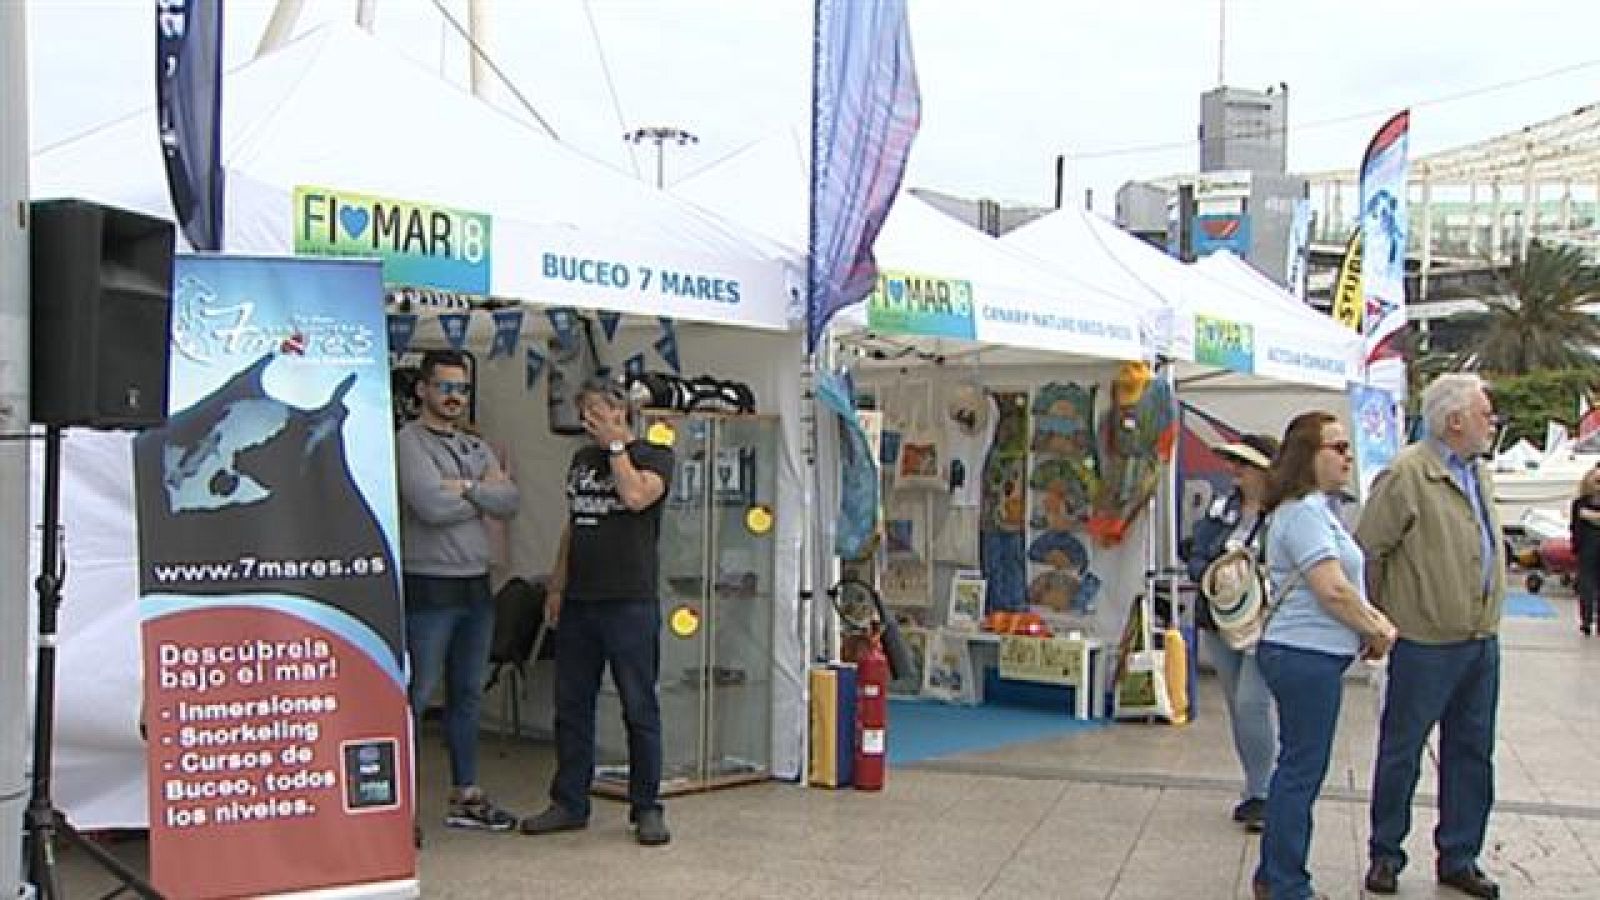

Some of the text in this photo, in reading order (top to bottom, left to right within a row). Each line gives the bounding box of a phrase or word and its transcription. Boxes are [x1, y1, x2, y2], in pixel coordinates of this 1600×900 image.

[542, 252, 741, 304] BUCEO 7 MARES
[154, 555, 386, 582] www.7mares.es
[160, 656, 338, 693] bajo el mar!
[179, 694, 337, 721] Inmersiones
[180, 721, 320, 746] Snorkeling
[181, 751, 274, 773] Cursos
[281, 744, 313, 763] de
[165, 778, 258, 799] Buceo,
[264, 769, 336, 791] todos
[166, 797, 316, 827] los niveles.
